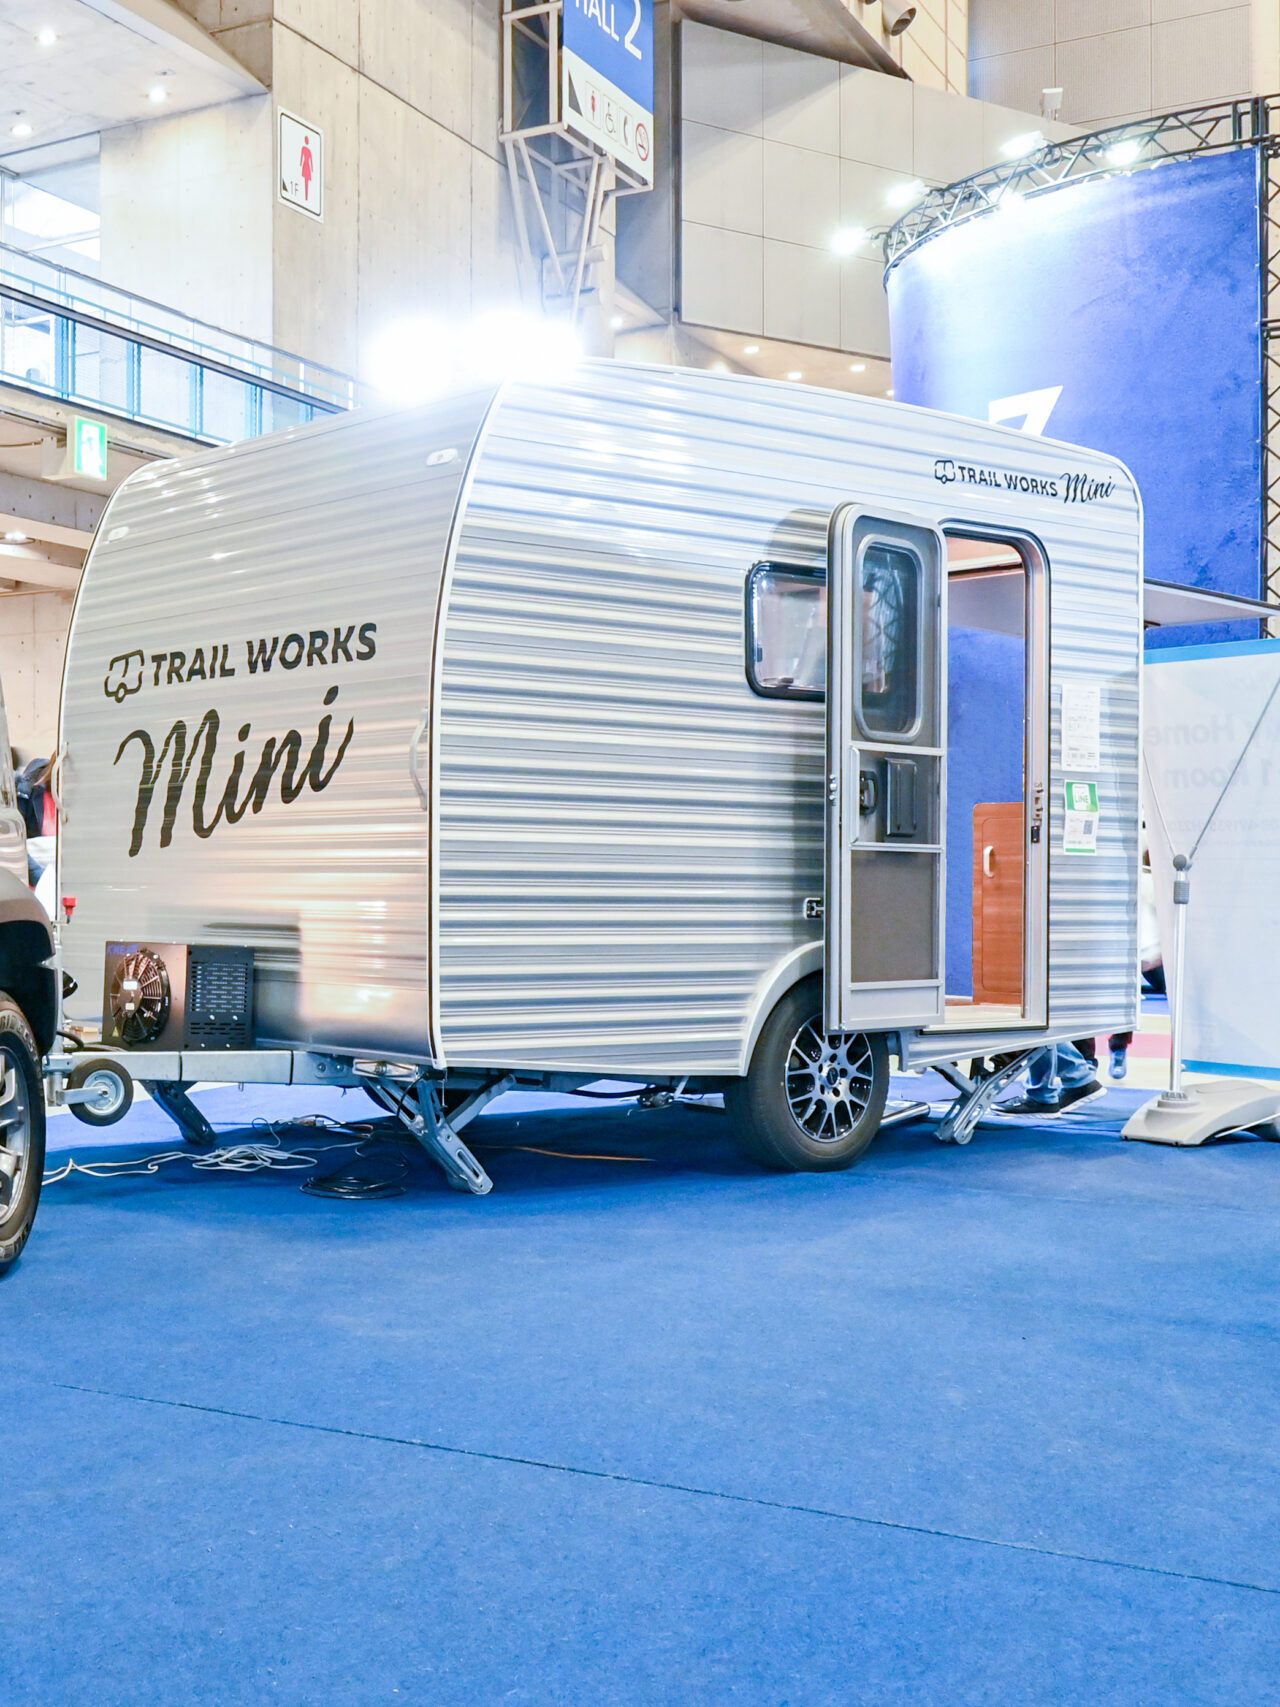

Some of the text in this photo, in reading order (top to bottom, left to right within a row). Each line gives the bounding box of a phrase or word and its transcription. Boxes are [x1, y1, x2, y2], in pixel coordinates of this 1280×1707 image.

[624, 0, 642, 60] 2
[290, 181, 299, 196] 1F
[958, 466, 1116, 504] TRAIL WORKS Mini
[151, 622, 377, 687] TRAIL WORKS
[113, 685, 355, 858] Mini
